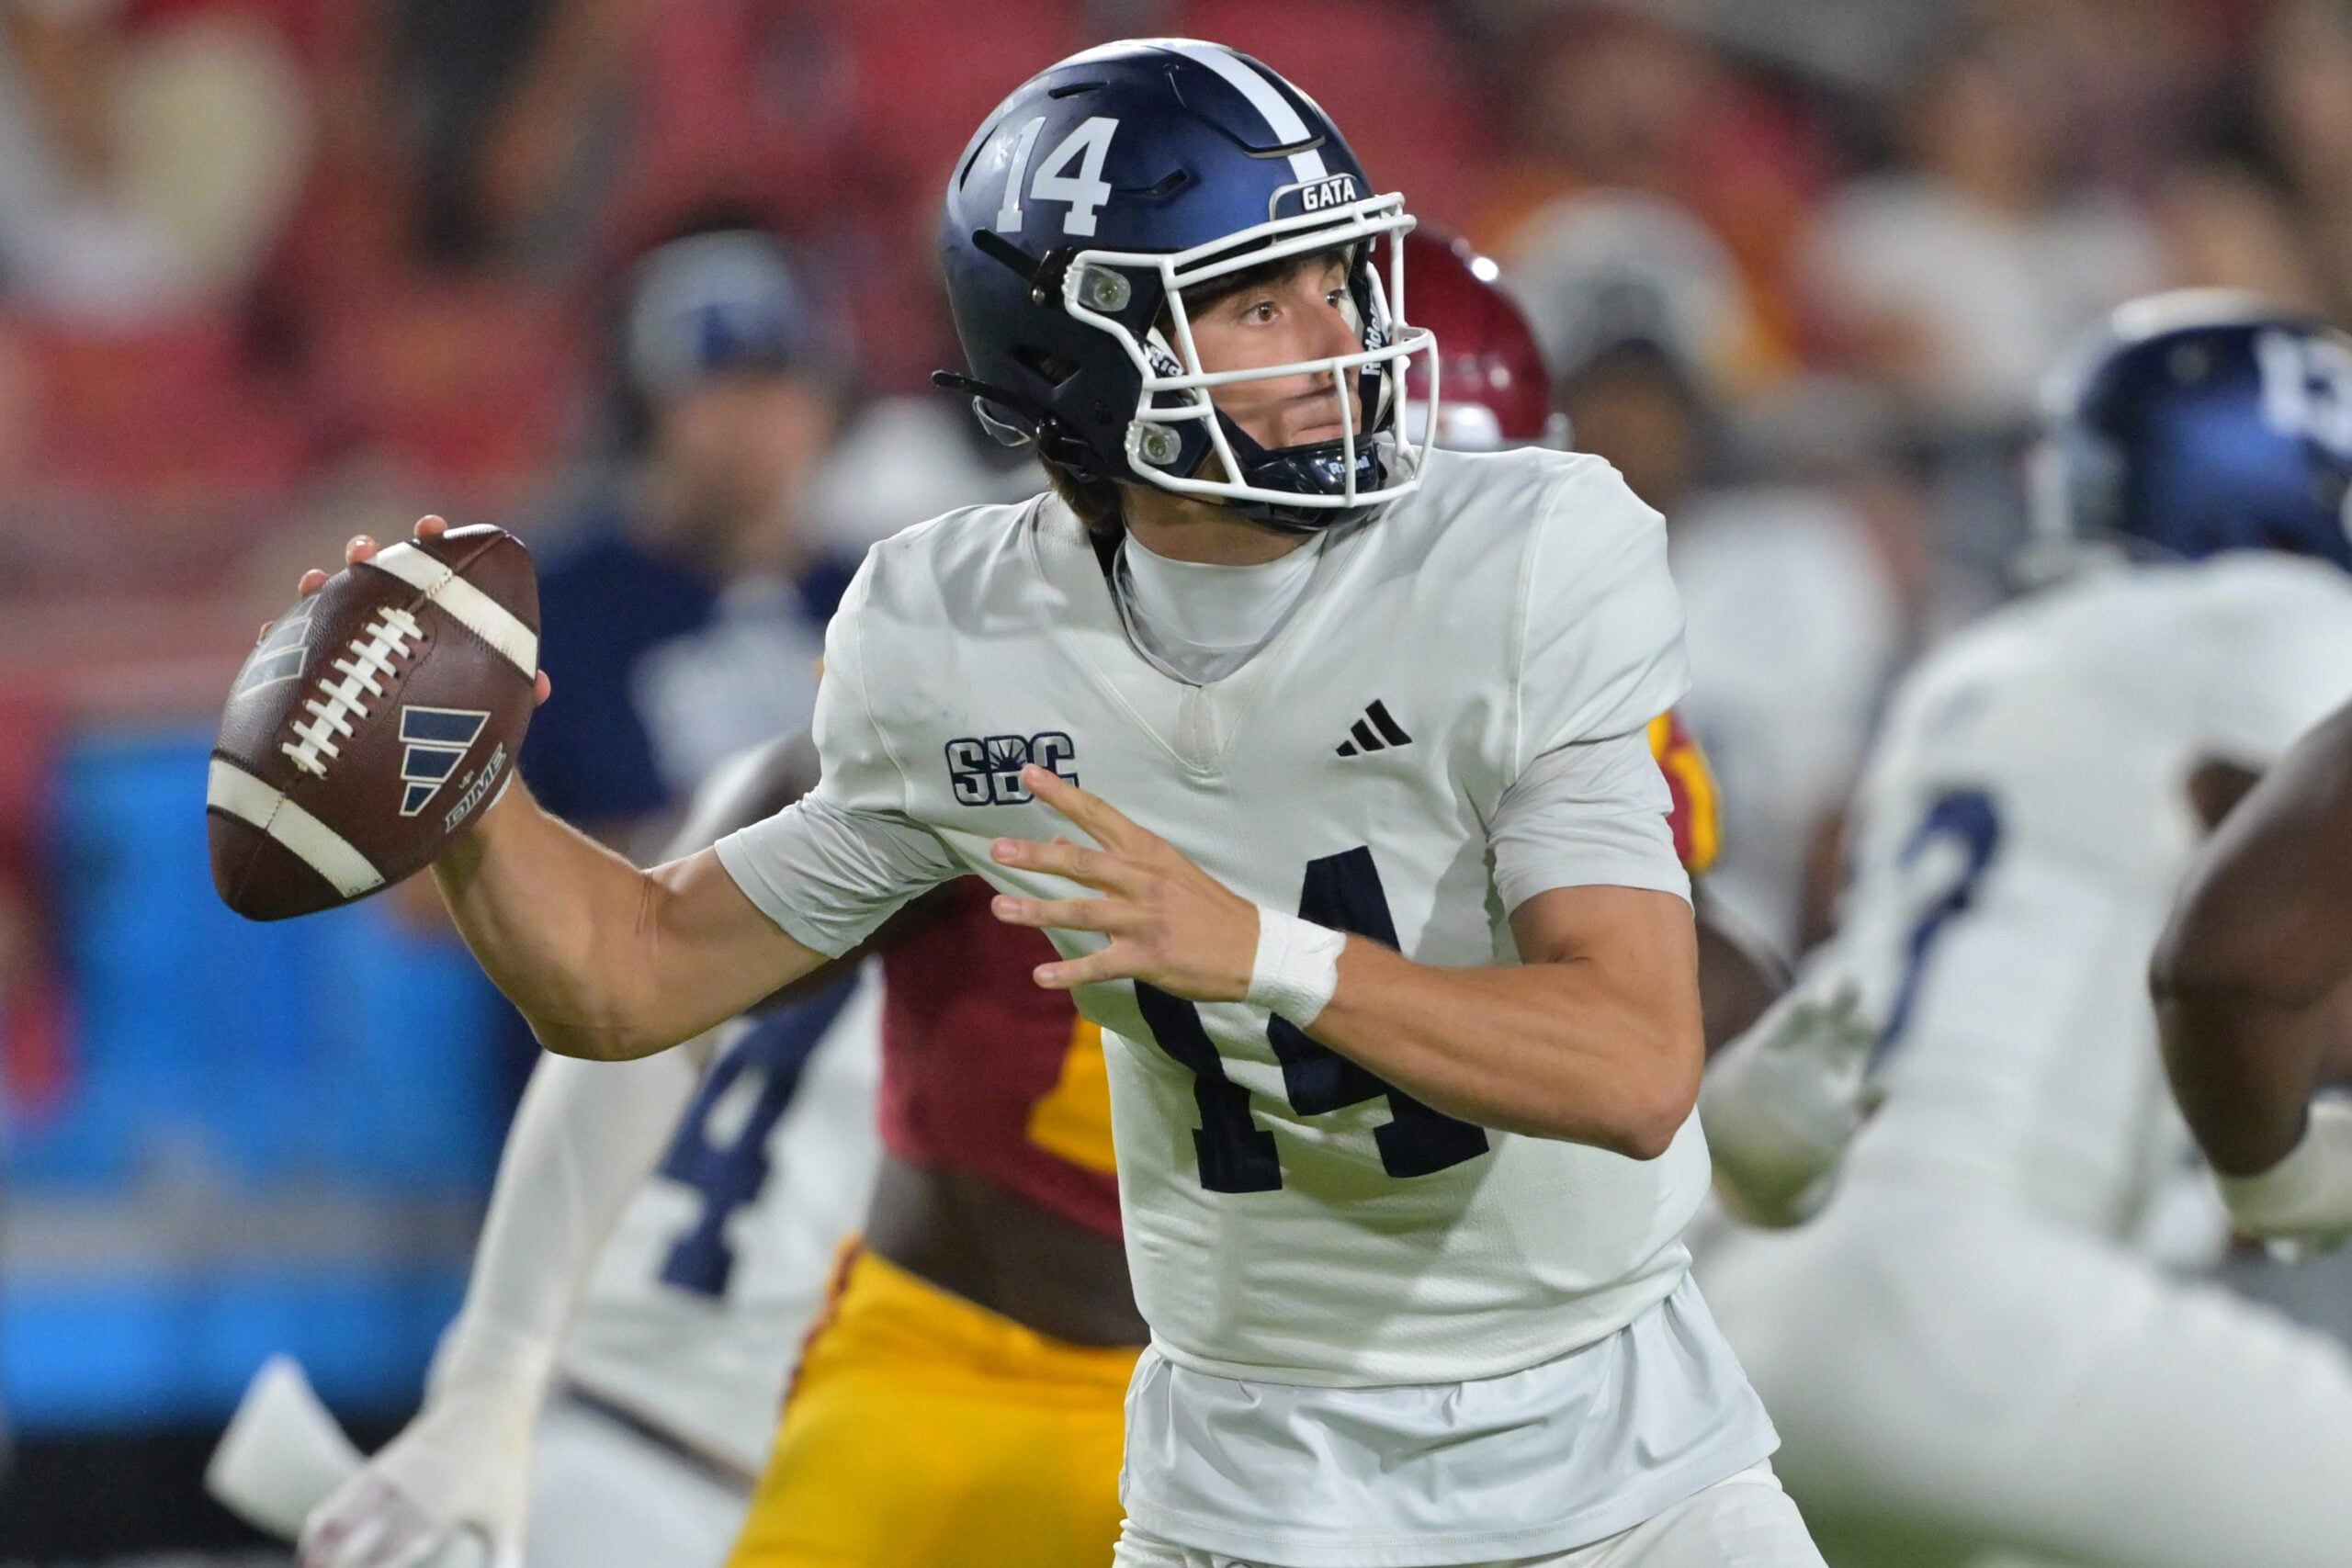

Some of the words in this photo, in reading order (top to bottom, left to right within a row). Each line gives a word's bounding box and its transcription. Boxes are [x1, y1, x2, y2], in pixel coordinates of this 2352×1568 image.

[997, 116, 1119, 237] 14
[1303, 177, 1356, 211] GATA
[1361, 301, 1382, 376] Rddell
[445, 741, 506, 833] DIME
[944, 731, 1080, 807] SBC
[1134, 846, 1490, 1194] 14
